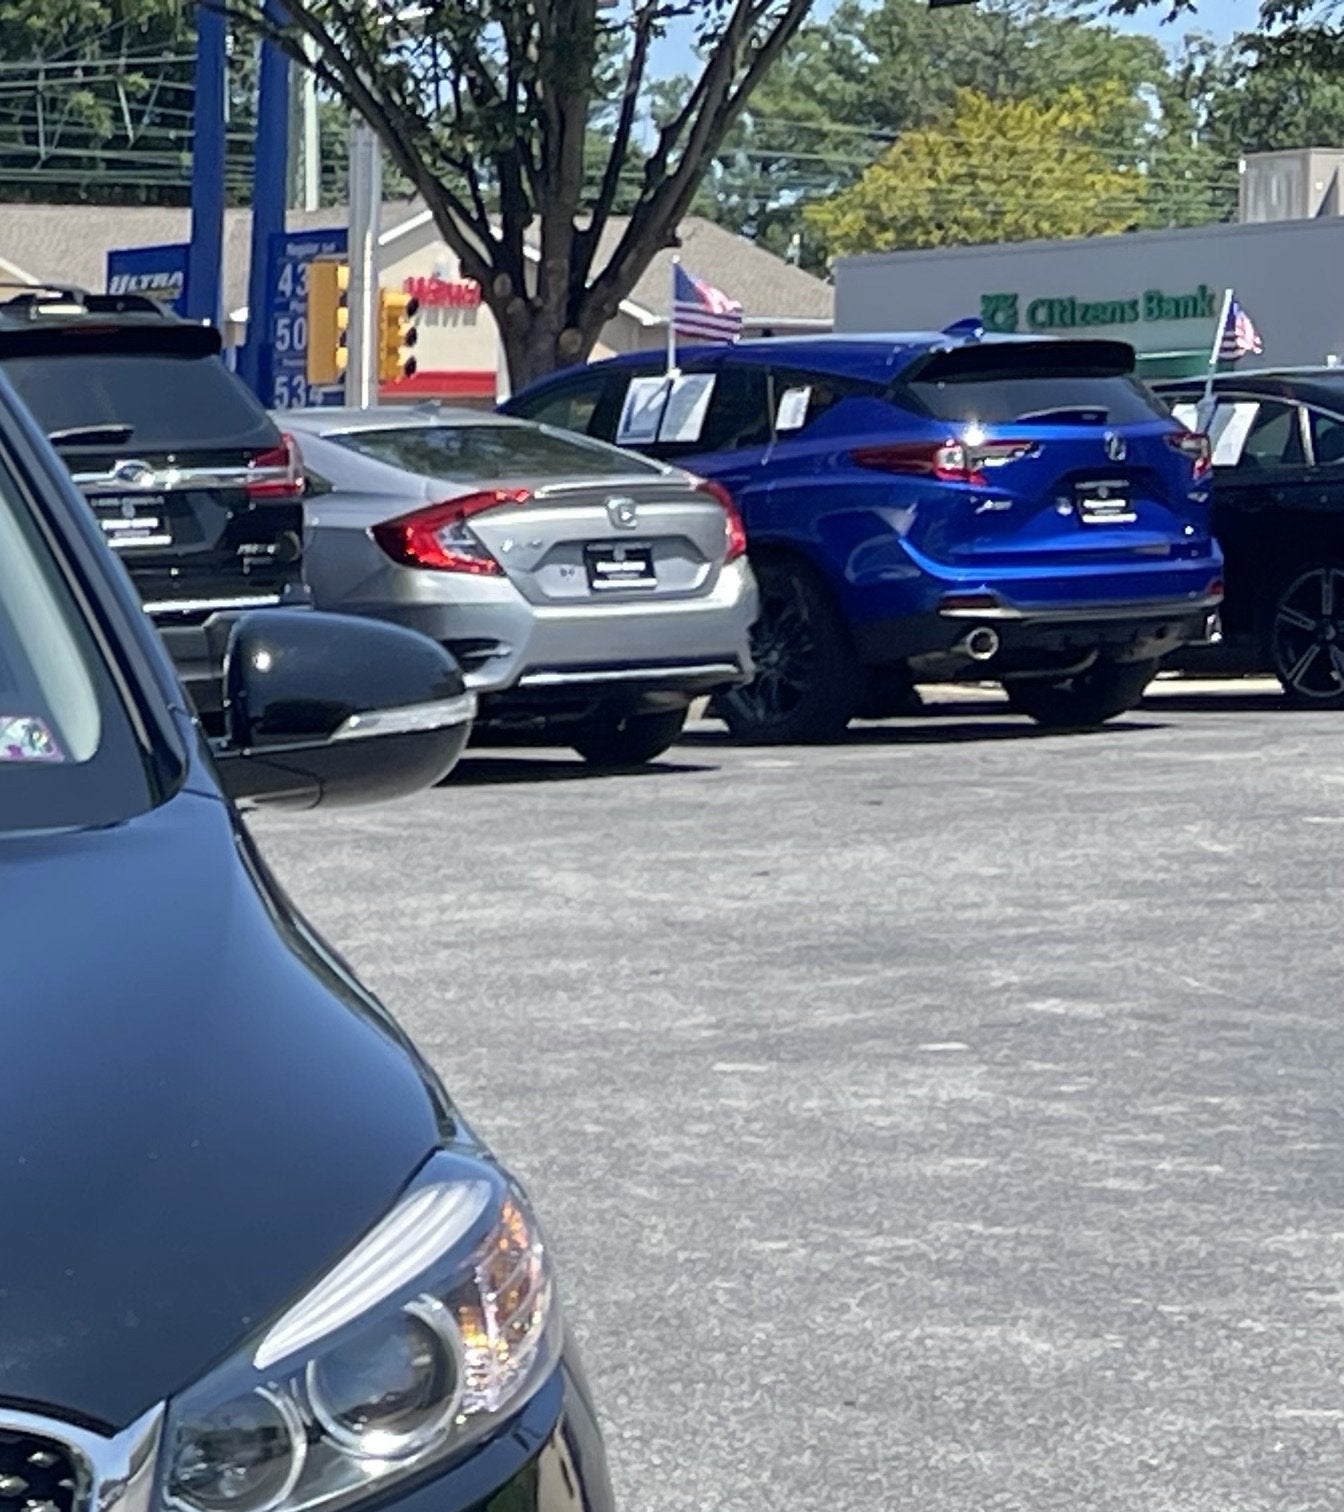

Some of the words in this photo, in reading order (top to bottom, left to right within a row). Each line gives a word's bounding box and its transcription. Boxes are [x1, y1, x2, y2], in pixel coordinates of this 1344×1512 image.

[109, 270, 184, 294] ULTRA
[278, 262, 307, 297] 43
[1026, 296, 1140, 329] Citizens
[1142, 284, 1216, 321] Bank
[275, 316, 307, 351] 50
